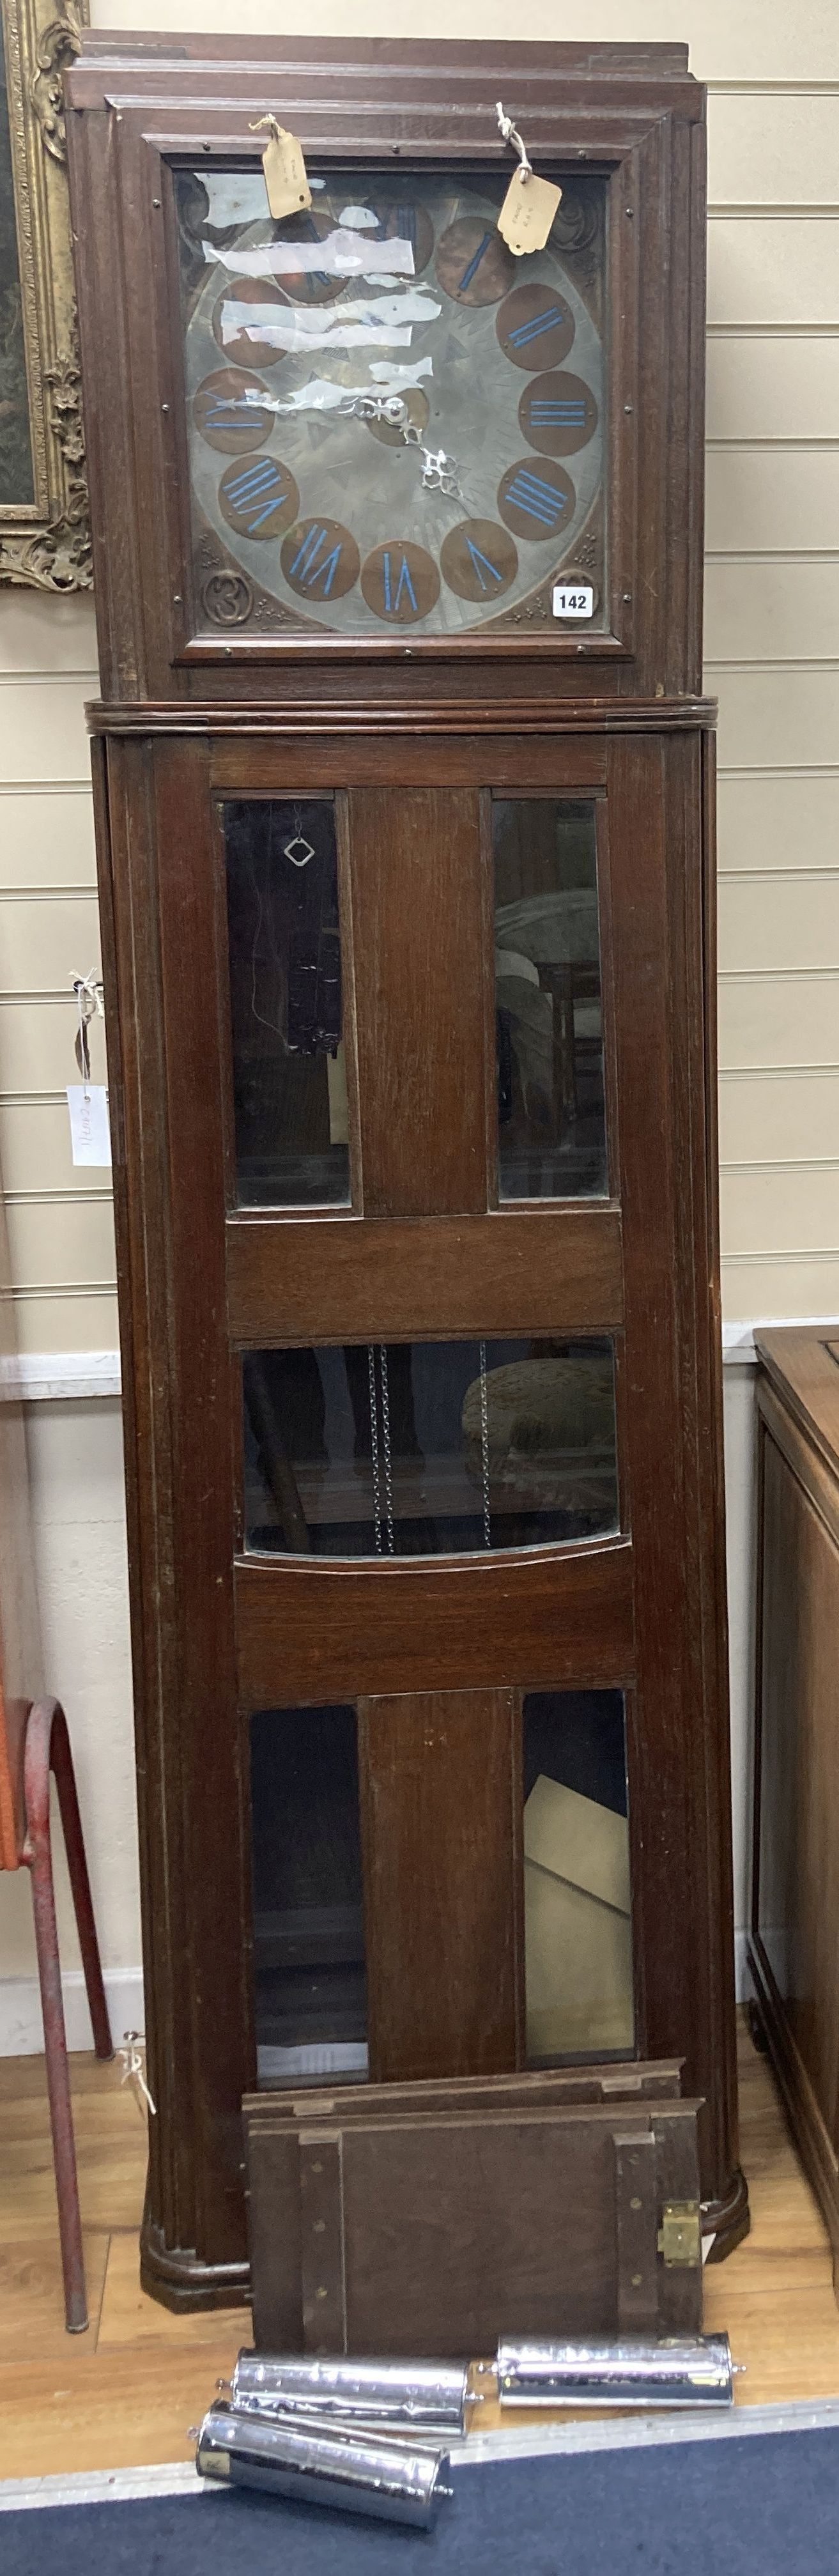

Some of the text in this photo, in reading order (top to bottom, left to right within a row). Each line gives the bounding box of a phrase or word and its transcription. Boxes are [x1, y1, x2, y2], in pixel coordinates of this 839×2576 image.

[508, 307, 563, 348] II
[530, 401, 586, 427] III
[222, 459, 289, 533] VIII
[289, 524, 343, 596] VII
[383, 552, 419, 612] VI
[466, 536, 503, 592] V
[559, 595, 587, 609] 142
